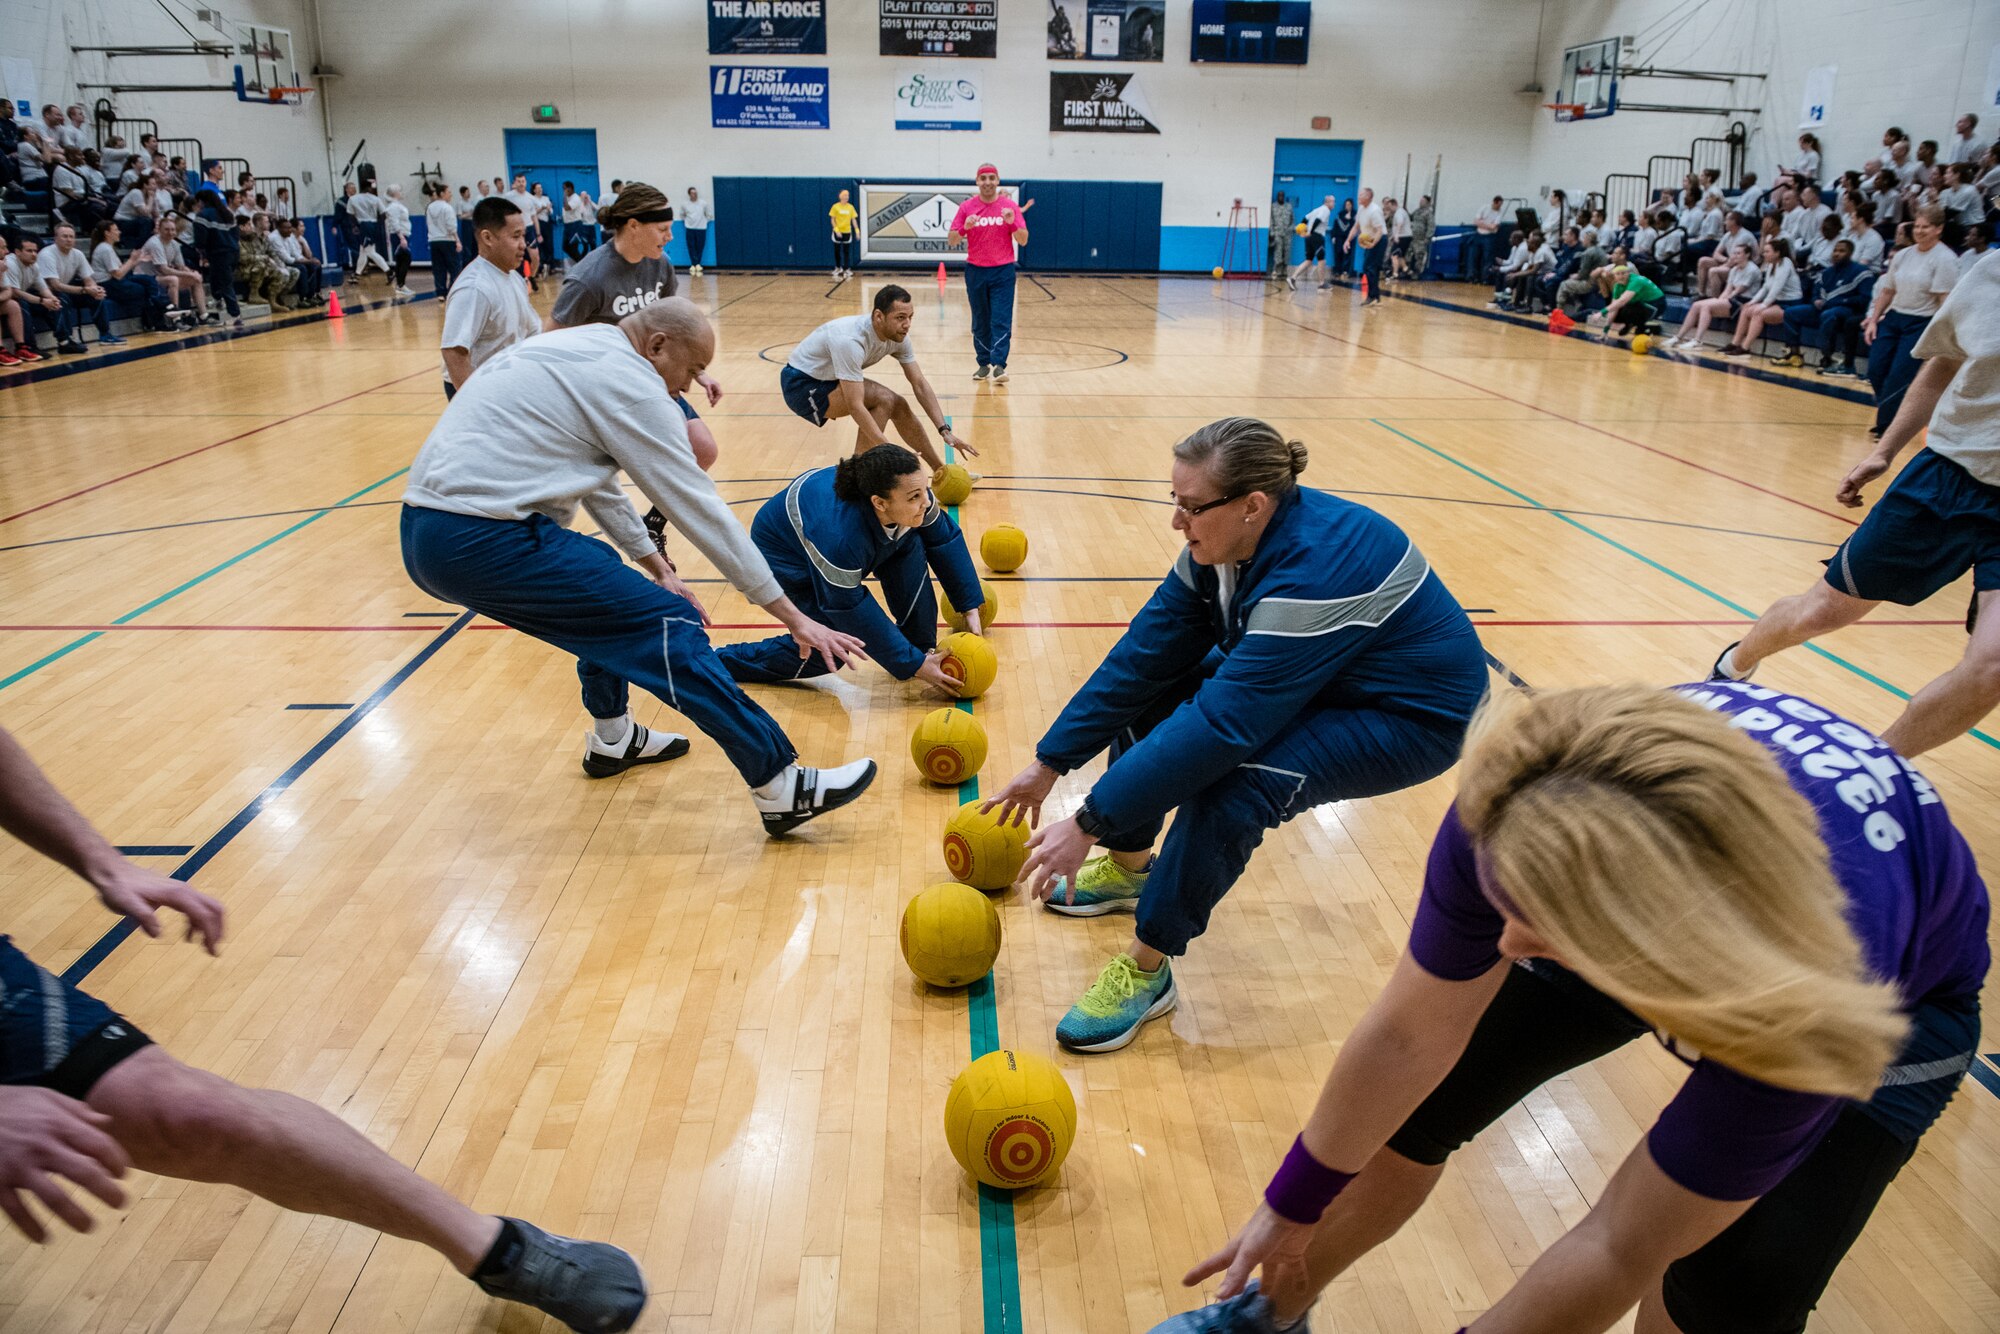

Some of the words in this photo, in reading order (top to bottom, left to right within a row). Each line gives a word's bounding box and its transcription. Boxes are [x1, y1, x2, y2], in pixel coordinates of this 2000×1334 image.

[713, 1, 742, 18] THE
[744, 1, 771, 18] AIR
[773, 1, 821, 18] FORCE
[885, 1, 910, 12] PLAY
[912, 2, 922, 12] IT
[923, 2, 955, 13] AGAIN
[957, 3, 992, 14] SPORTS
[881, 19, 901, 29] 2015
[903, 19, 913, 29] W
[914, 19, 935, 29] HWY
[937, 20, 950, 31] 50,
[951, 20, 996, 31] O'FALLON
[1200, 24, 1225, 36] HOME
[1275, 26, 1304, 37] GUEST
[905, 30, 972, 41] 618-628-2345
[1240, 30, 1263, 38] PERIOD
[743, 69, 787, 82] FIRST
[740, 82, 824, 96] COMMAND
[1063, 100, 1100, 117] FIRST
[1103, 101, 1140, 118] WATC
[876, 198, 913, 227] JAMES
[612, 281, 664, 316] Grief
